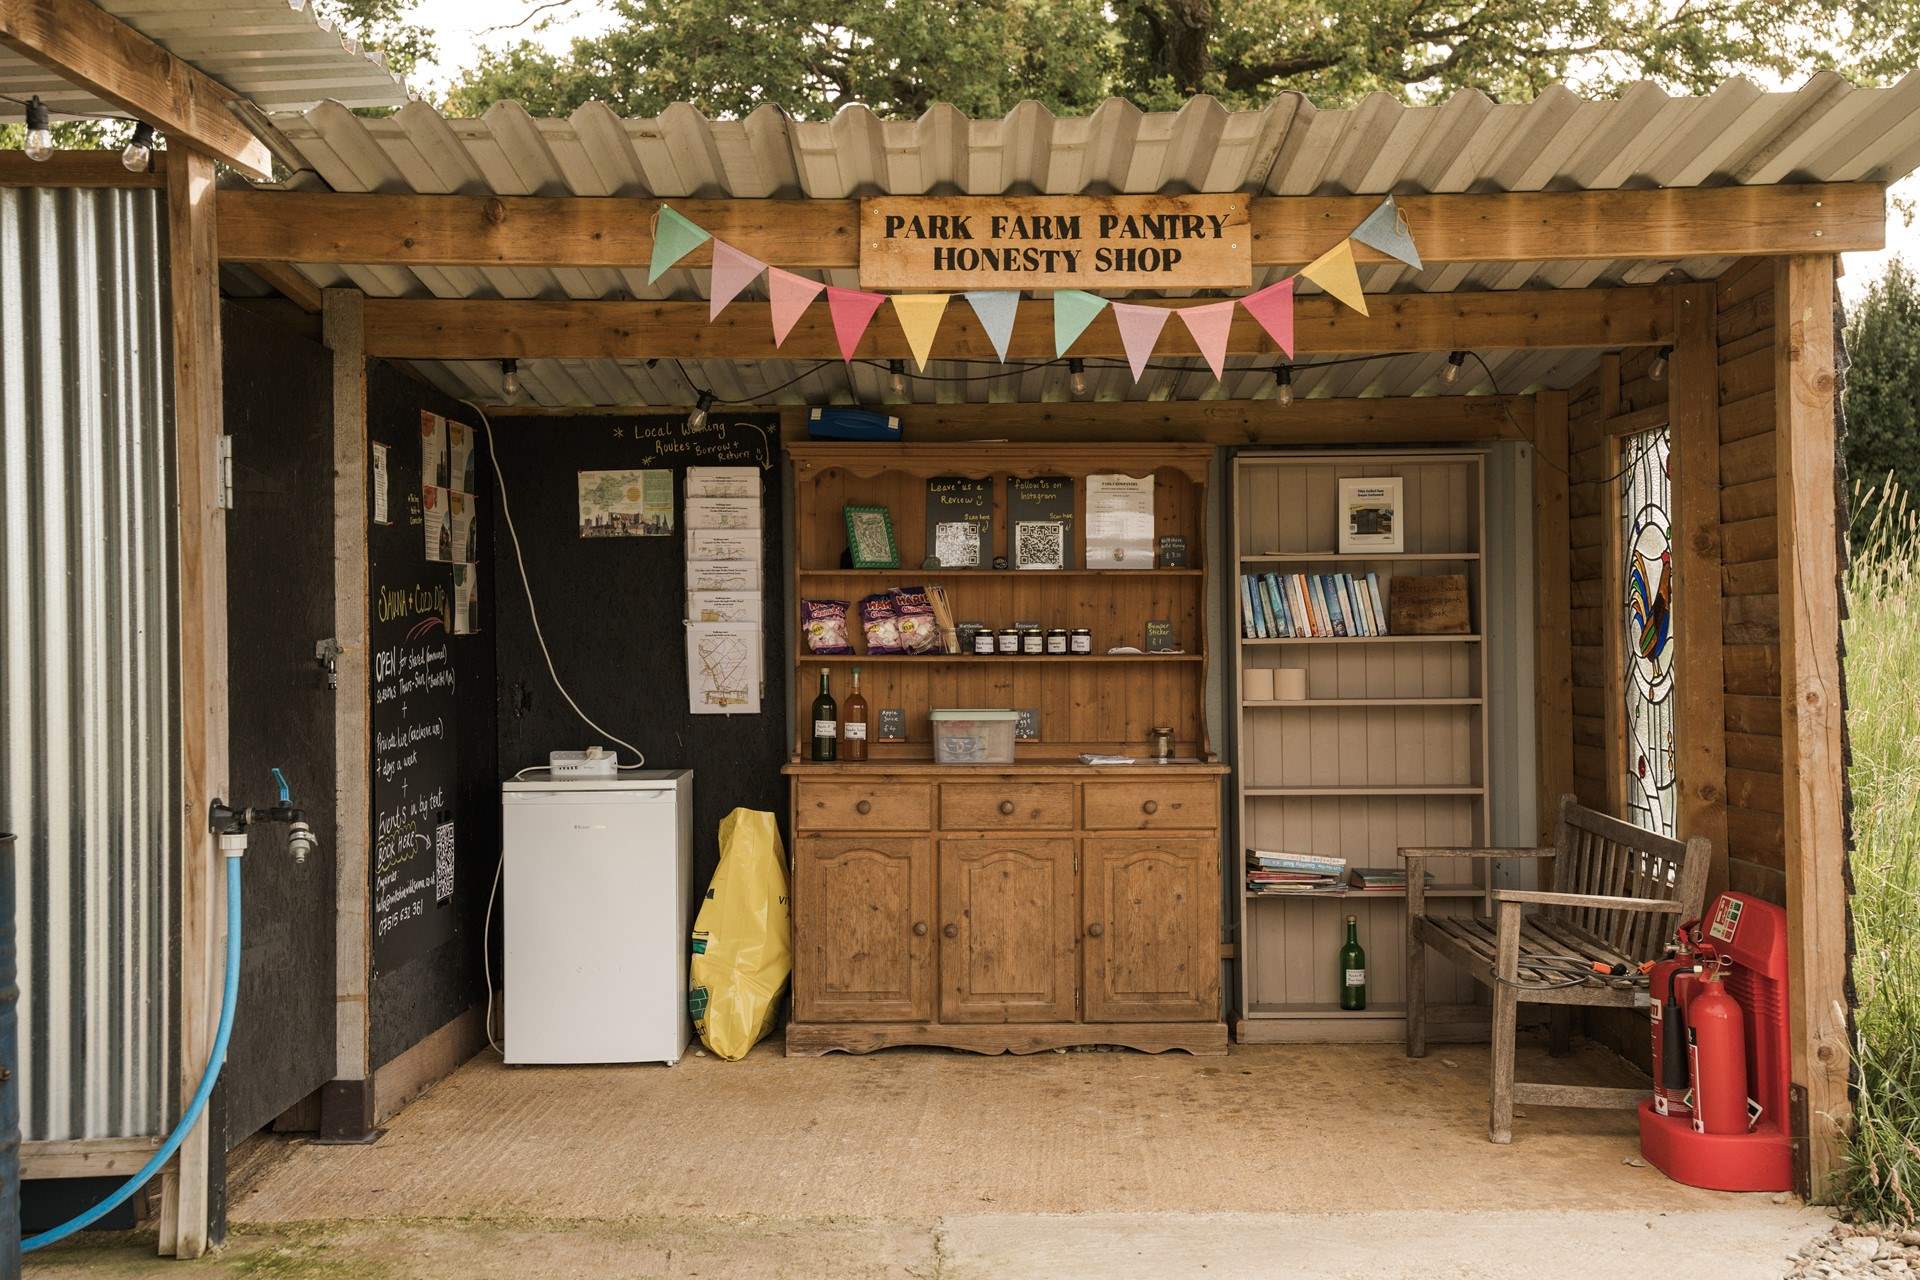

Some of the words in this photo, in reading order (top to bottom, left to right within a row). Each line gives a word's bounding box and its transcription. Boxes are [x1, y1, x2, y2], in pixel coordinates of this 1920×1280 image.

[884, 215, 974, 240] PARK
[991, 215, 1081, 240] FARM
[1099, 214, 1230, 240] PANTRY
[933, 246, 1081, 273] HONESTY
[1094, 246, 1182, 272] SHOP
[634, 421, 672, 439] Local
[681, 422, 725, 440] Waking
[695, 443, 731, 456] Borrow
[718, 449, 750, 462] Return
[930, 482, 956, 492] Leave
[961, 483, 972, 491] us
[940, 495, 973, 504] Review
[1020, 491, 1057, 504] Instagram
[378, 584, 408, 623] SAUNA
[415, 583, 433, 614] COLD
[376, 645, 396, 683] OPEN
[398, 647, 407, 675] for
[376, 731, 396, 754] Private
[382, 758, 396, 781] days
[403, 749, 418, 767] week
[378, 805, 407, 841] Events
[419, 793, 428, 821] big
[430, 785, 444, 810] tent
[378, 842, 396, 870] BOOK
[397, 830, 415, 853] HERE
[378, 911, 399, 937] 07515
[412, 899, 424, 916] 361
